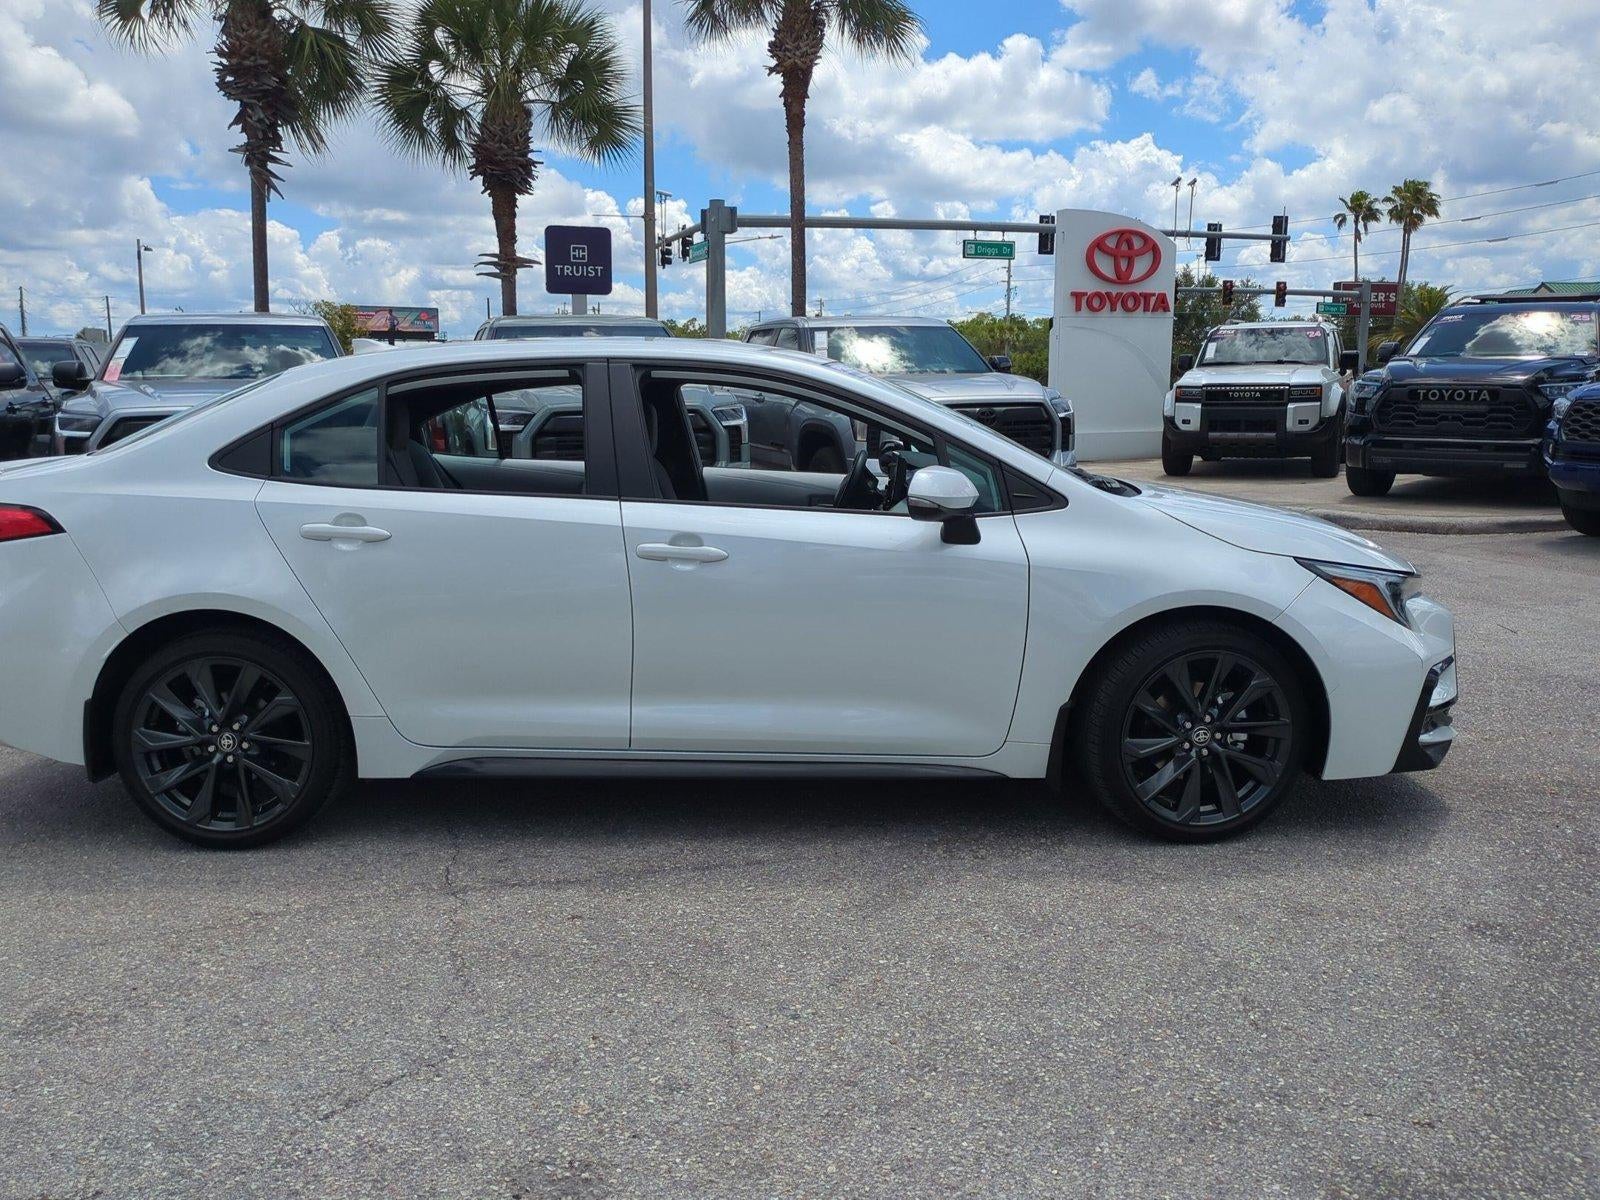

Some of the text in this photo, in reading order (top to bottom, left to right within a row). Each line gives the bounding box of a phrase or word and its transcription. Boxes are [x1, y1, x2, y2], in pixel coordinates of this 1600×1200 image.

[977, 245, 1011, 256] Driggs Dr
[554, 264, 604, 277] TRUIST
[1070, 290, 1171, 313] TOYOTA
[1418, 389, 1491, 401] TOYOTA
